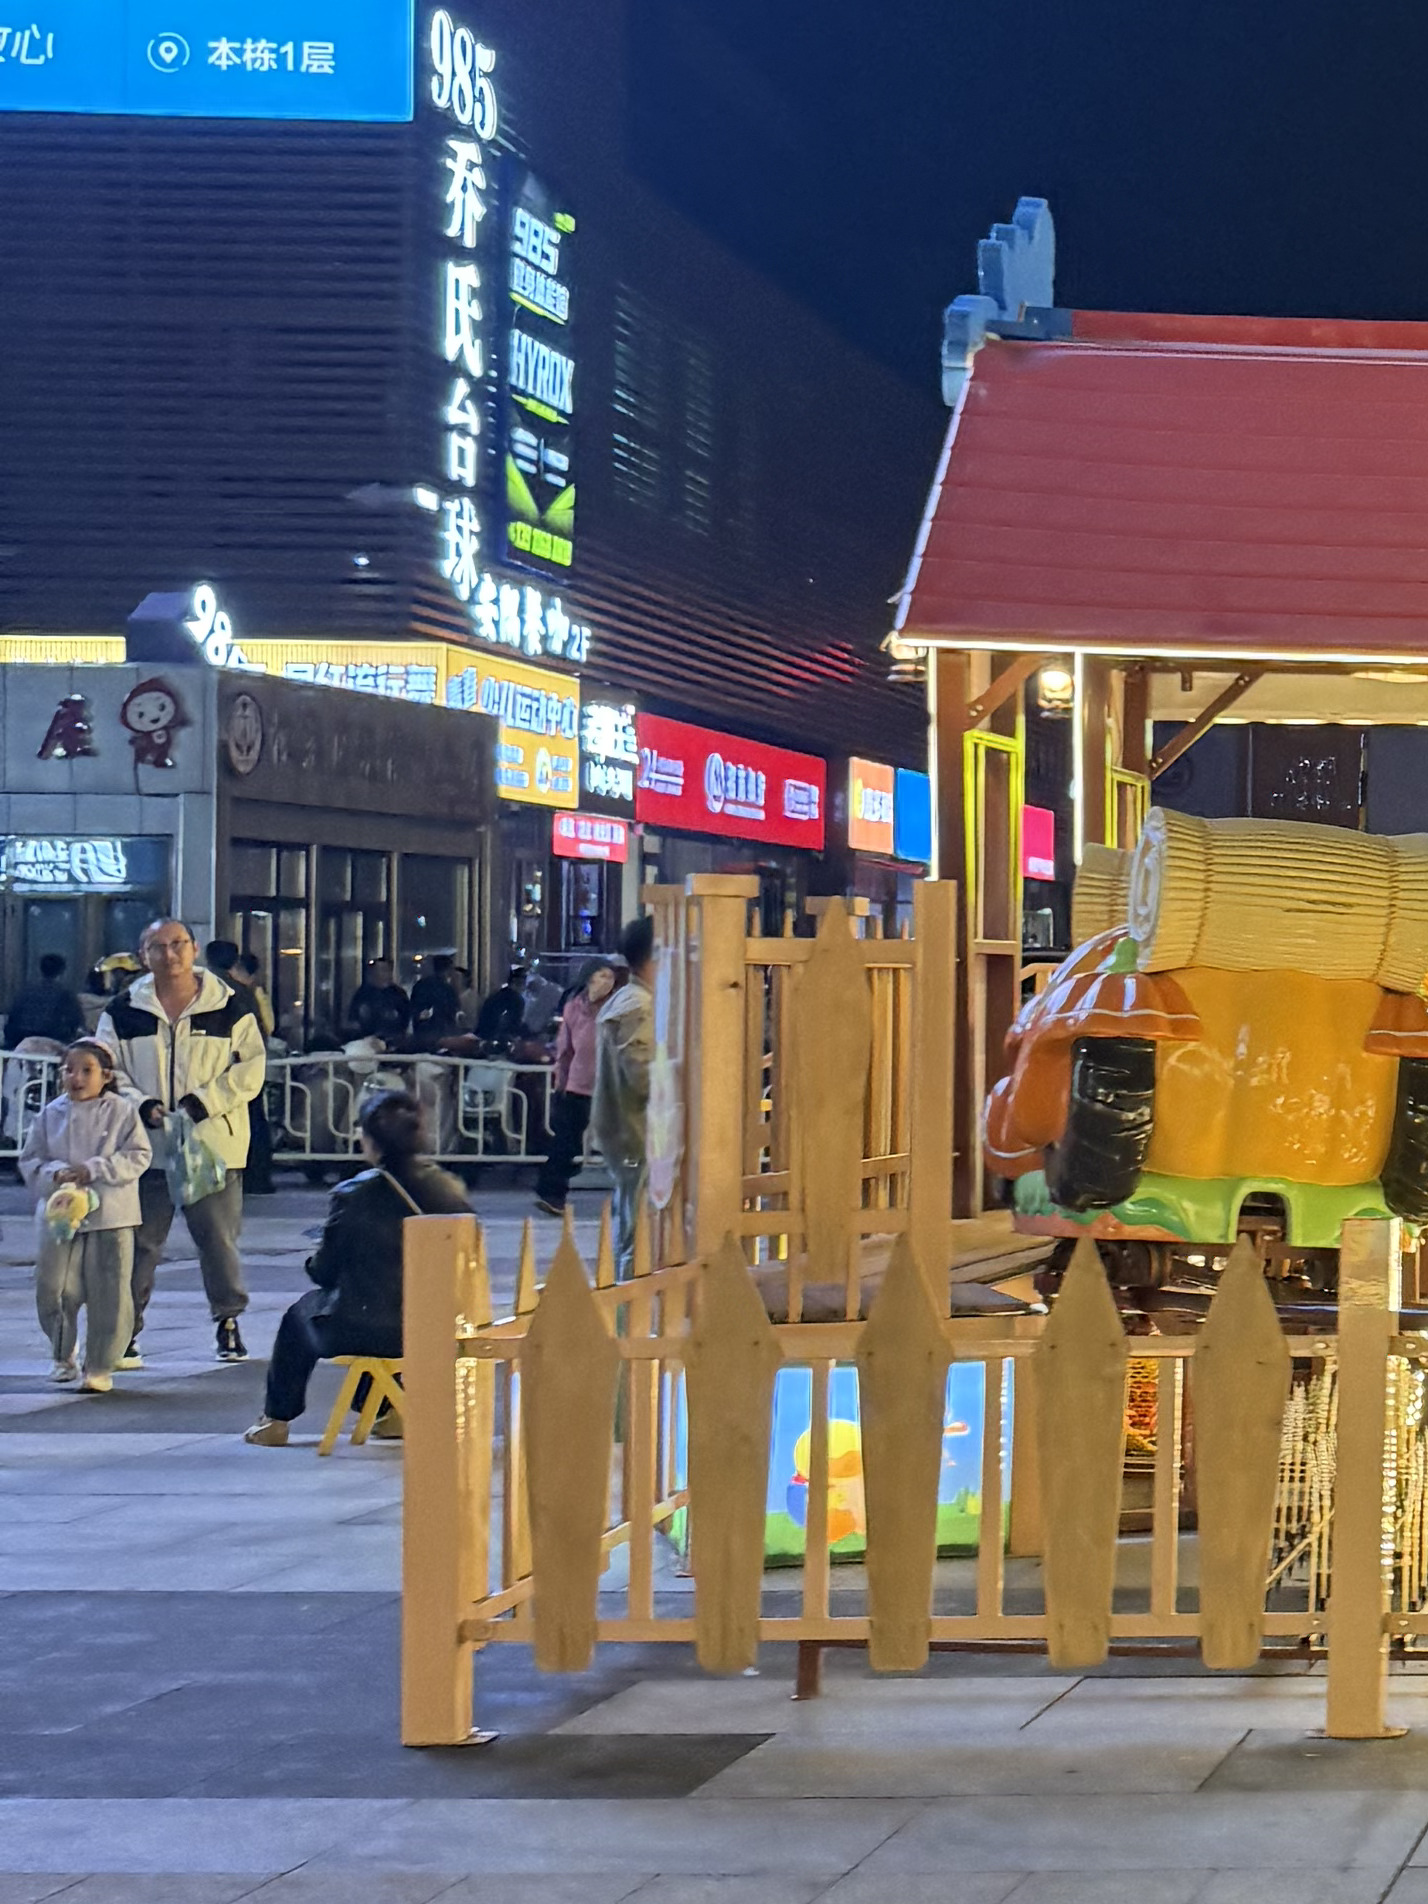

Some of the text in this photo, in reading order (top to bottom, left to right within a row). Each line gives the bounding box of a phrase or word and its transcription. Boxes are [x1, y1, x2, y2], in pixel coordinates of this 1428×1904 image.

[207, 37, 335, 75] 本栋1层
[431, 9, 497, 141] 985
[511, 207, 561, 275] 985
[443, 138, 487, 602] 乔氏台球
[509, 328, 575, 414] HYROX
